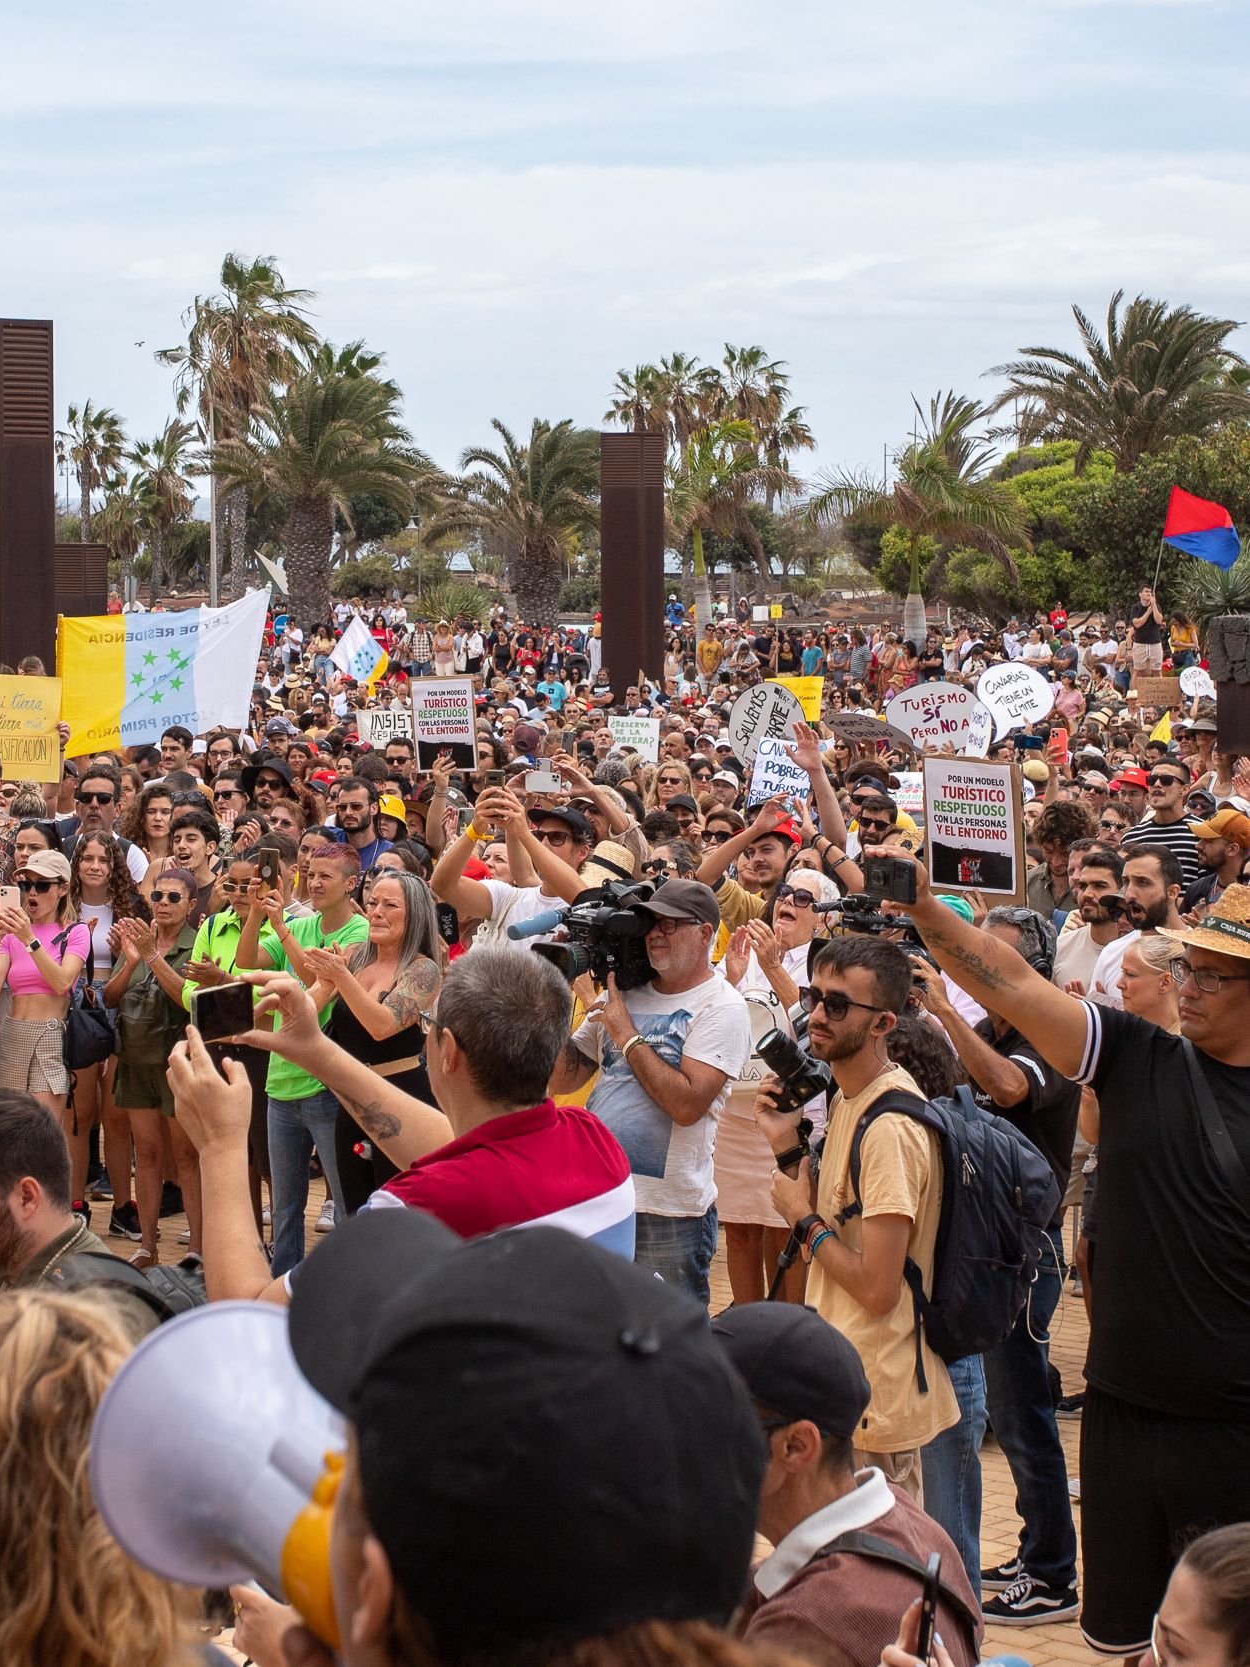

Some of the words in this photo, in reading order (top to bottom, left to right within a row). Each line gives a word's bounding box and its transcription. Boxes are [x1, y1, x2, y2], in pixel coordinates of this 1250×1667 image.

[984, 668, 1031, 696] CANARIAS
[423, 697, 468, 709] TURÍSTICO
[994, 690, 1023, 707] TIENE
[1021, 686, 1035, 700] UN
[418, 708, 468, 719] RESPETUOSO
[735, 688, 768, 747] SALVEMOS
[922, 705, 941, 724] SÍ
[369, 730, 410, 741] RESIST
[426, 727, 435, 735] EL
[436, 726, 470, 735] ENTORNO
[910, 724, 939, 740] PERO
[940, 717, 958, 734] NO
[613, 736, 655, 748] IOSFERA?
[947, 774, 962, 784] POR
[963, 776, 974, 785] UN
[975, 777, 1005, 787] MODELO
[762, 780, 810, 800] TURISMO
[941, 785, 1006, 803] TURÍSTICO
[933, 799, 1007, 817] RESPETUOSO
[933, 814, 949, 824] CON
[949, 816, 964, 826] LAS
[965, 818, 1007, 828] PERSONAS
[936, 824, 943, 835] Y
[945, 826, 956, 836] EL
[958, 826, 1008, 840] ENTORNO
[1220, 922, 1236, 933] CAJA
